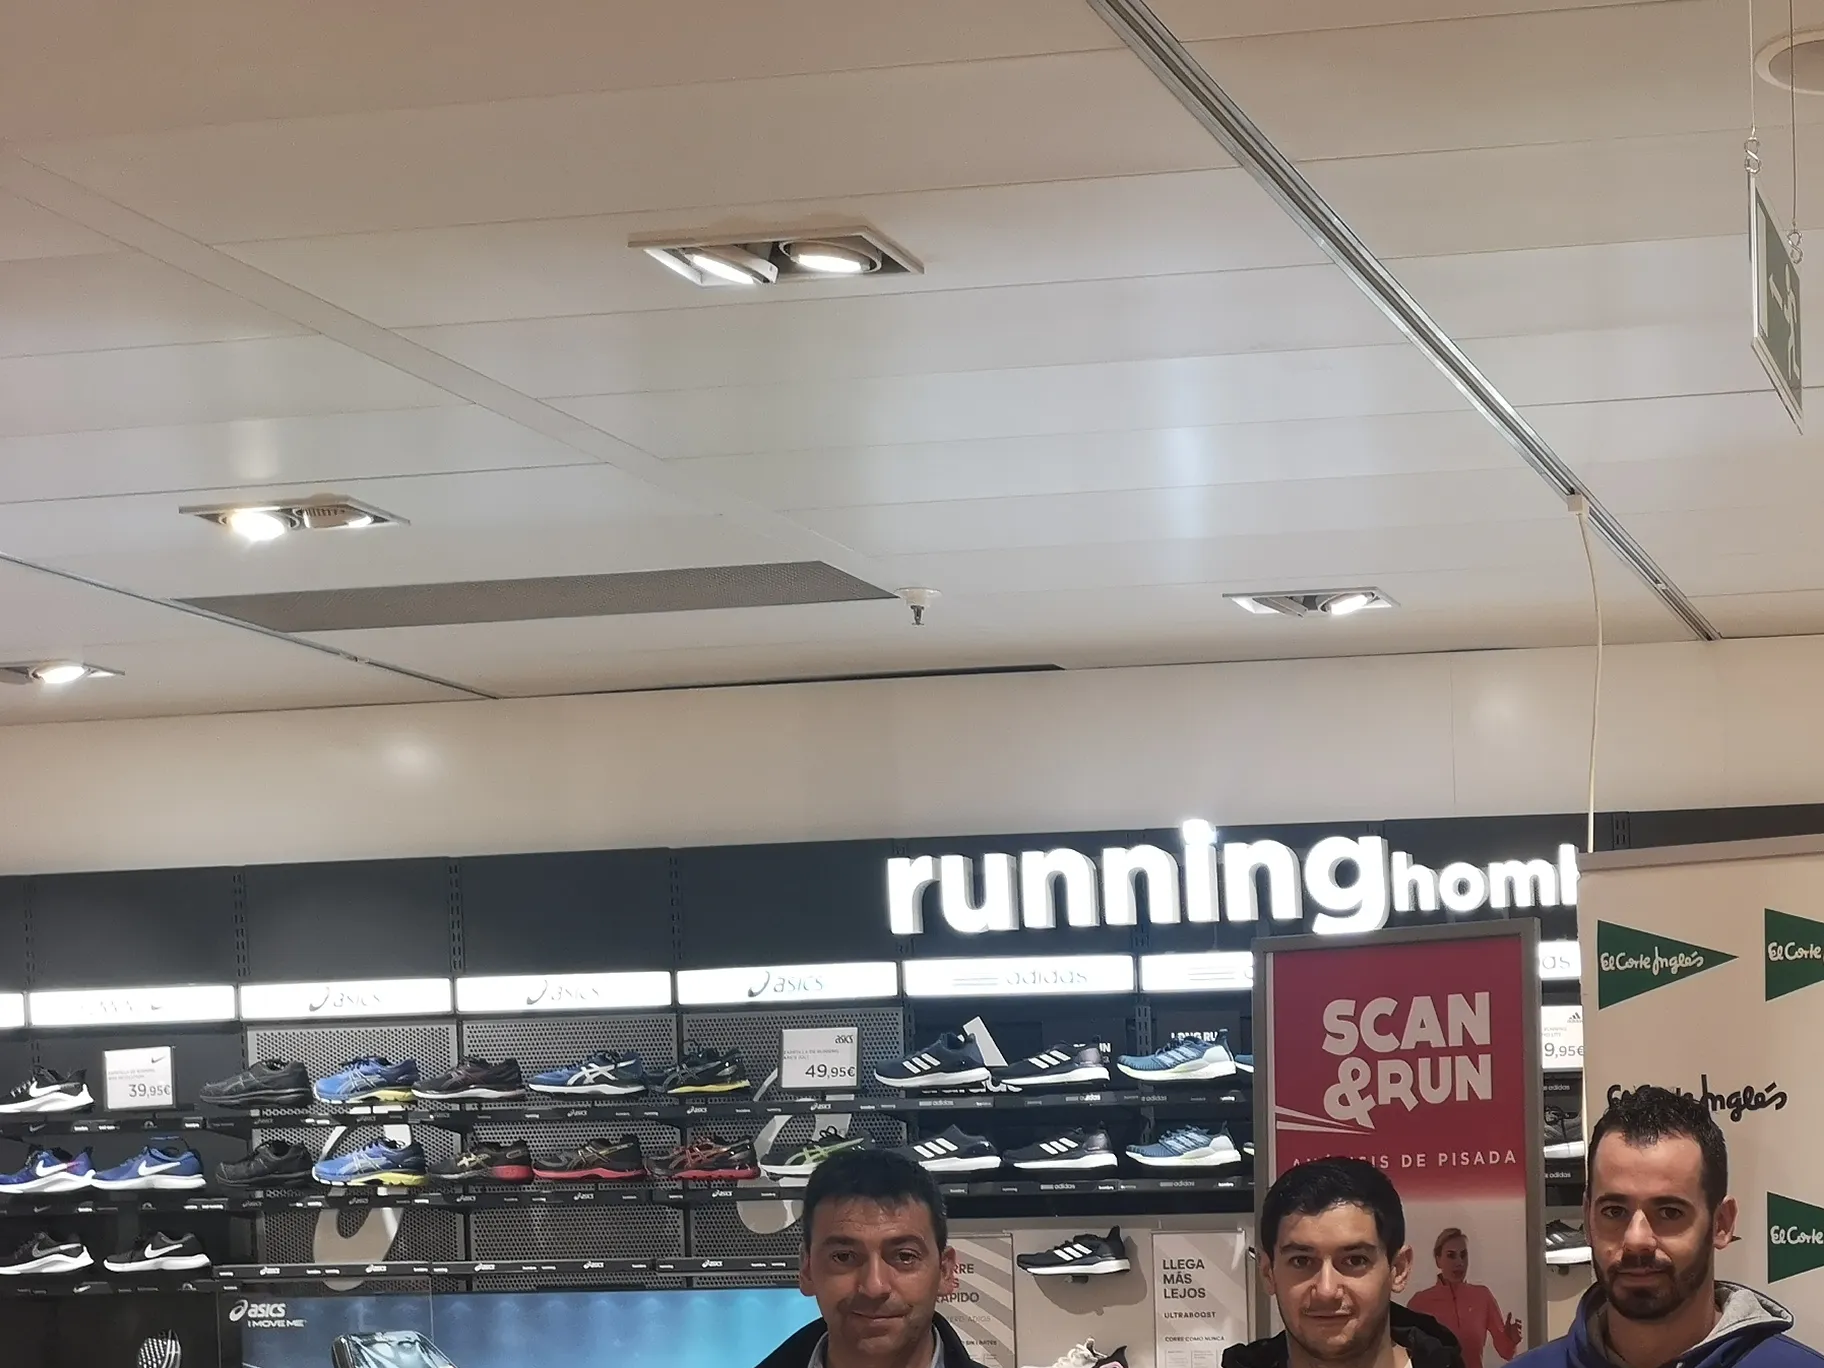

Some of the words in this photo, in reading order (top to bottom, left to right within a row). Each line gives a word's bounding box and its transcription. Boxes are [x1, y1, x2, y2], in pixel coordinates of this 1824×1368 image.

[887, 819, 1391, 934] running
[1768, 942, 1784, 962] El
[1785, 941, 1821, 960] Corte
[1600, 952, 1615, 971] El
[1616, 952, 1651, 970] Corte
[1652, 946, 1704, 976] Inglés
[1322, 992, 1491, 1056] SCAN
[804, 1063, 856, 1079] 49,95€
[129, 1083, 172, 1099] 39,95€
[1324, 1053, 1493, 1130] &RUN
[1401, 1153, 1427, 1169] DE
[1438, 1149, 1517, 1166] PISADA
[1771, 1226, 1786, 1244] El
[1787, 1226, 1823, 1245] Corte
[1163, 1258, 1205, 1270] LLEGA
[1163, 1270, 1193, 1285] MÁS
[1163, 1287, 1207, 1299] LEJOS
[248, 1303, 286, 1318] asics
[1164, 1311, 1217, 1319] ULTRABOOST
[253, 1320, 283, 1328] MOVE
